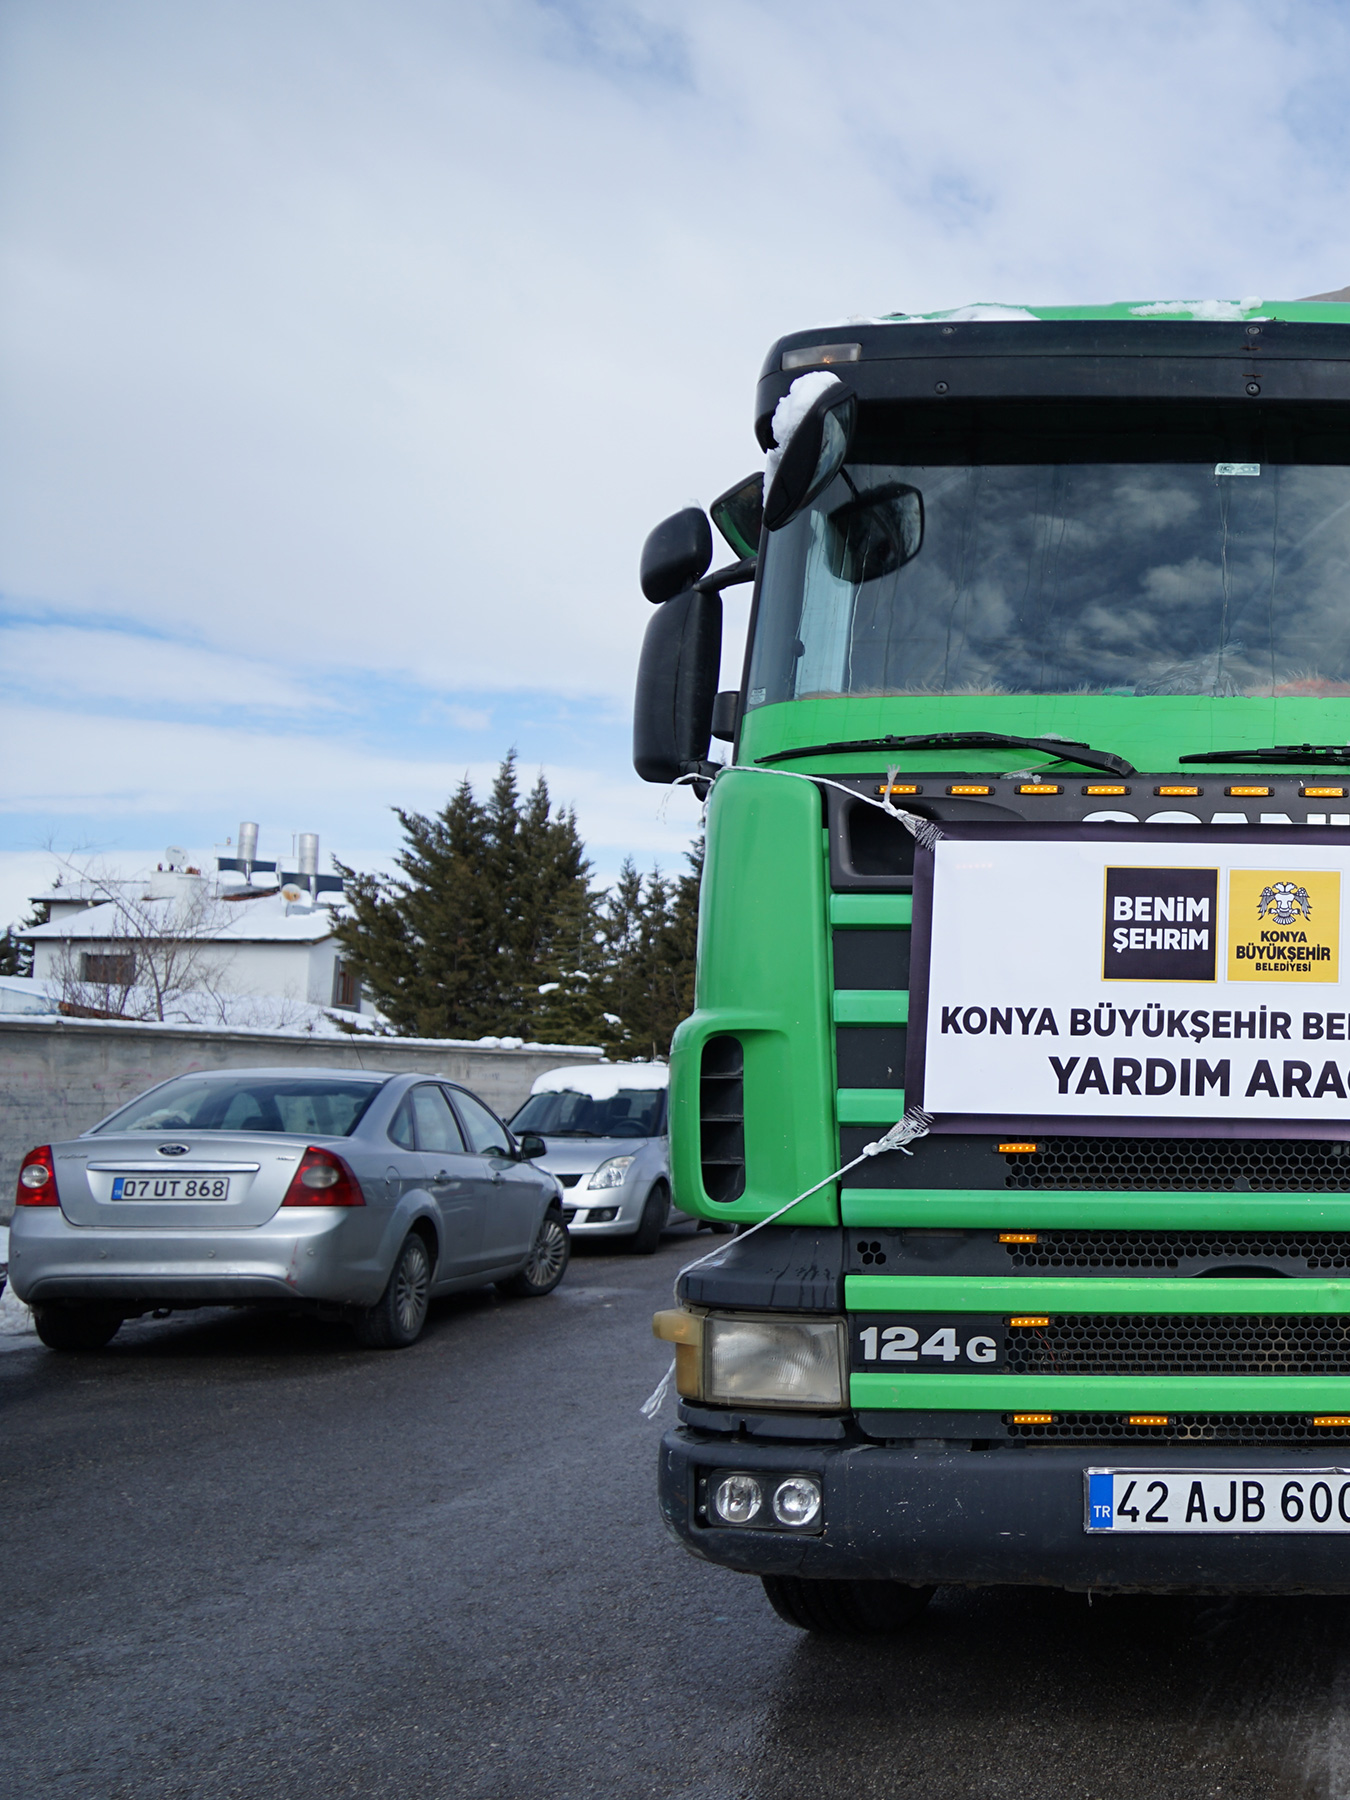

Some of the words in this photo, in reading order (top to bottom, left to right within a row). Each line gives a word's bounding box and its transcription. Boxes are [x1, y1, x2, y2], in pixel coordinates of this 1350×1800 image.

[1260, 930, 1308, 943] KONYA
[1236, 943, 1331, 962] BÜYÜKŞEHİR
[1255, 961, 1312, 972] BELEDİYESİ
[941, 1006, 1060, 1036] KONYA
[1070, 1002, 1292, 1044] BÜYÜKŞEHİR
[1048, 1056, 1231, 1097] YARDIM
[123, 1180, 150, 1197] 07
[154, 1180, 181, 1197] UT
[185, 1180, 225, 1197] 868
[1093, 1505, 1111, 1518] TR
[1116, 1480, 1169, 1523] 42
[1184, 1480, 1267, 1523] AJB
